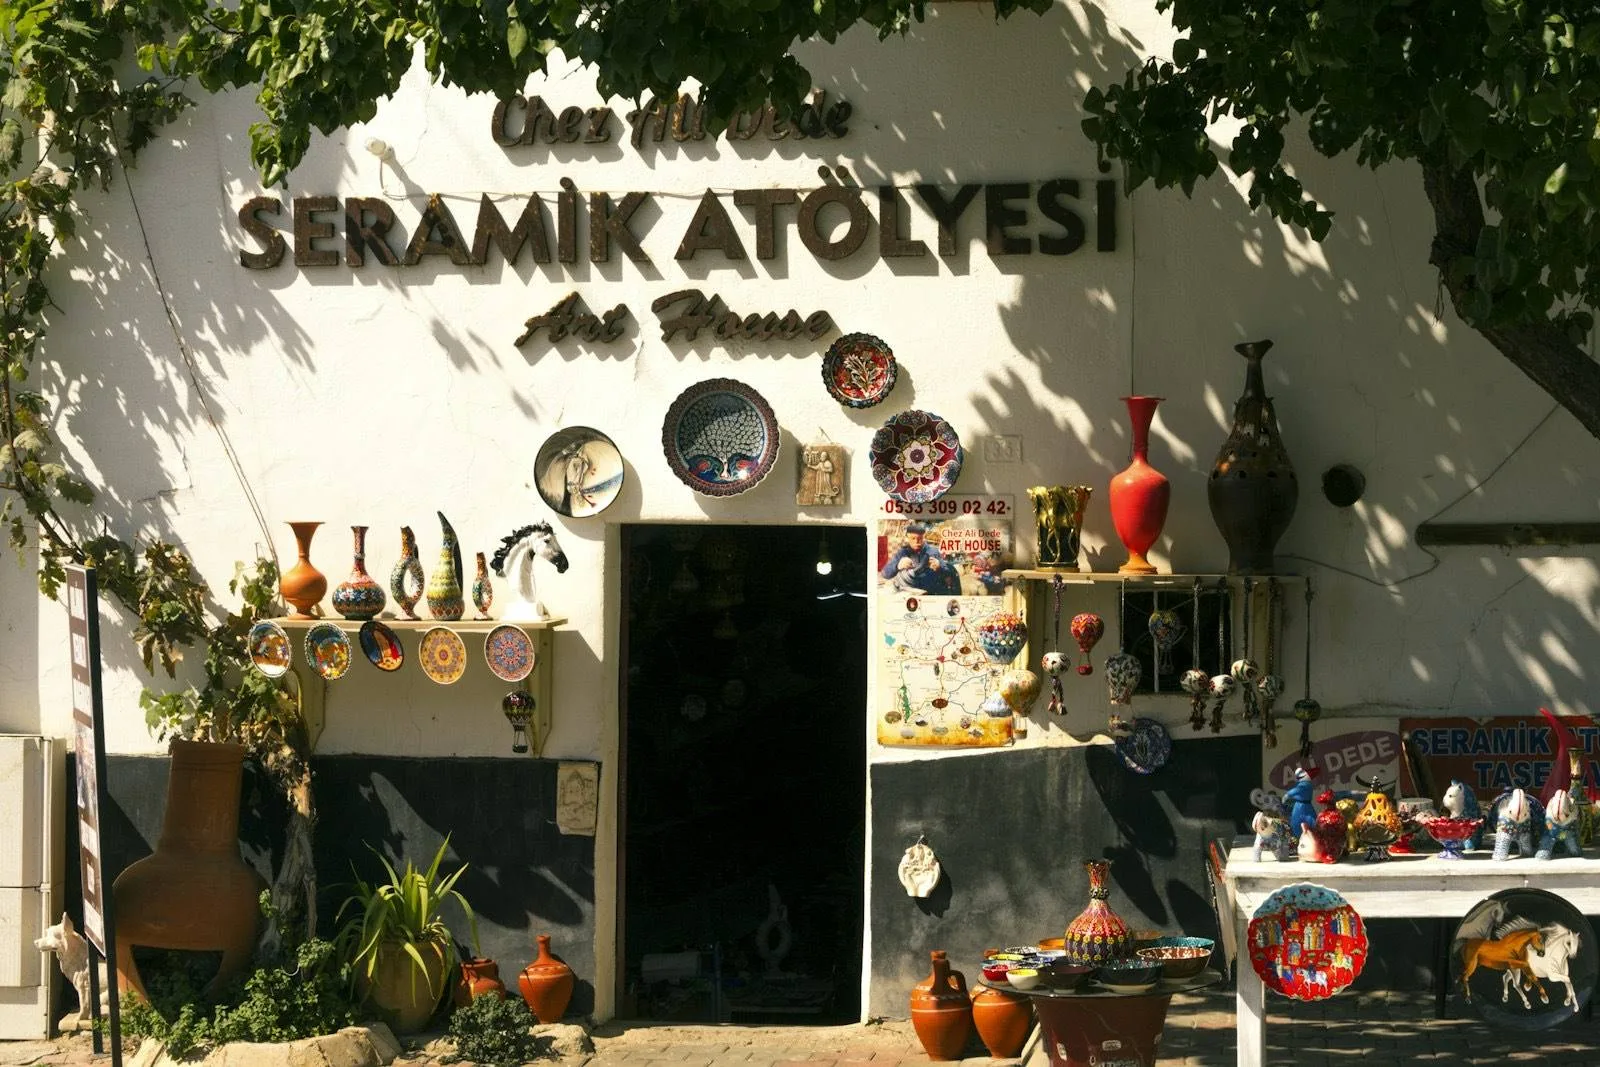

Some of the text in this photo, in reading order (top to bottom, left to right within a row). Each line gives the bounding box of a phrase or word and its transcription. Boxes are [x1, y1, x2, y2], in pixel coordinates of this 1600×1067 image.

[491, 94, 612, 147] Chez
[238, 159, 1117, 270] SERAMİK ATÖLYESİ
[514, 289, 832, 347] Art House
[928, 500, 957, 514] 309
[962, 500, 981, 514] 02
[986, 500, 1006, 514] 42
[940, 540, 1001, 551] ART HOUSE
[941, 529, 1001, 538] Chez Ali Dede
[1324, 736, 1395, 772] DEDE
[1411, 720, 1552, 755] SERAMİK
